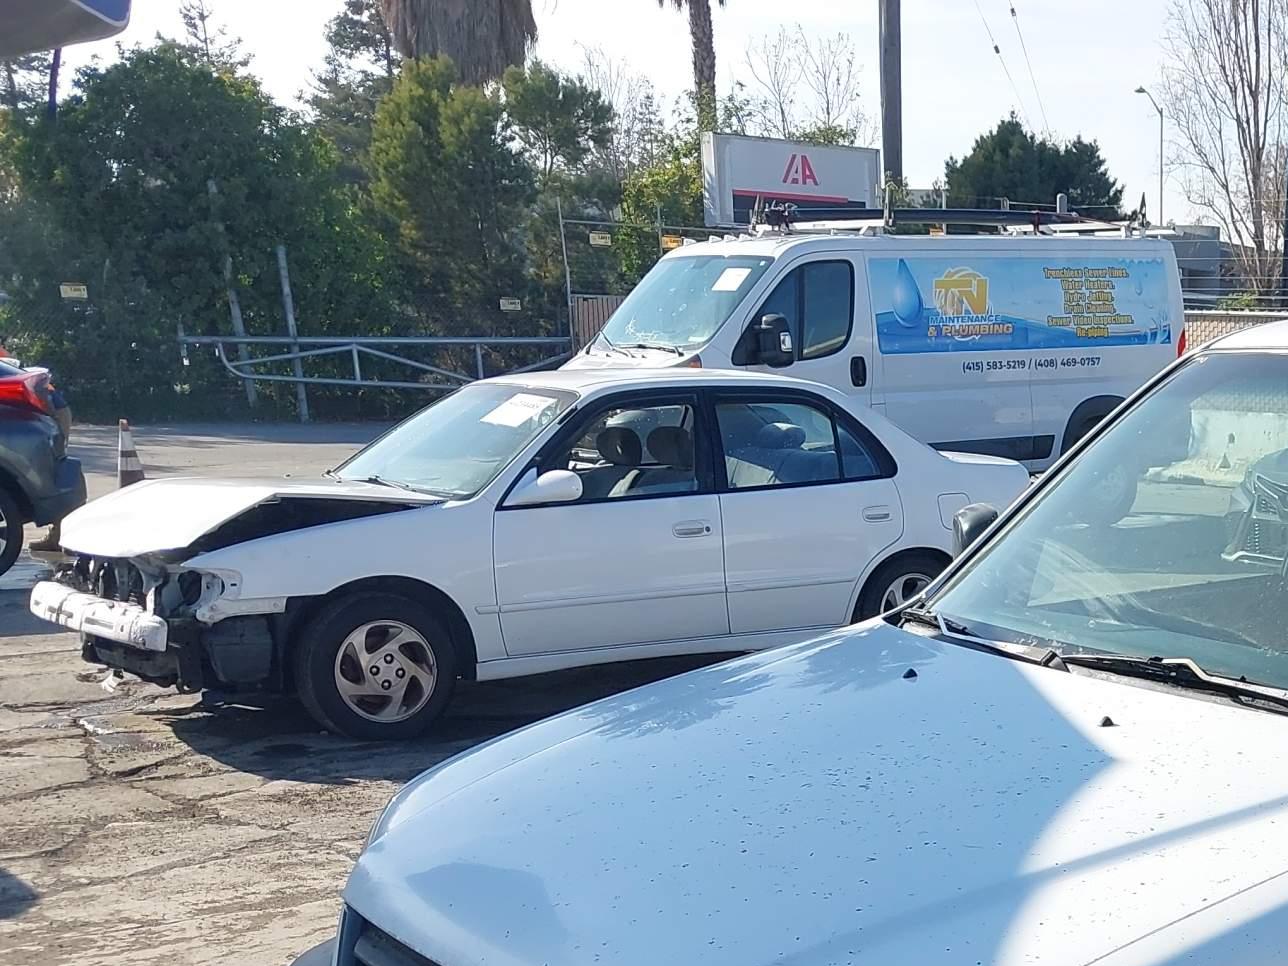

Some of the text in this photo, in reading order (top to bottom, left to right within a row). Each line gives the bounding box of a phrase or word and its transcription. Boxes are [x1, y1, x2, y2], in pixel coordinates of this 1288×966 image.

[1043, 267, 1083, 278] Trenchless
[1061, 280, 1083, 290] Water
[1064, 291, 1086, 303] Hydro
[1064, 303, 1084, 314] Drain
[929, 314, 1001, 325] MAINTENANCE
[1047, 315, 1071, 327] Sewer
[1072, 315, 1092, 326] Video
[928, 322, 1014, 337] & PLUMBING
[962, 360, 984, 374] (415)
[986, 359, 1026, 371] 583-5219
[1034, 357, 1058, 370] (408)
[1060, 356, 1101, 368] 469-0757
